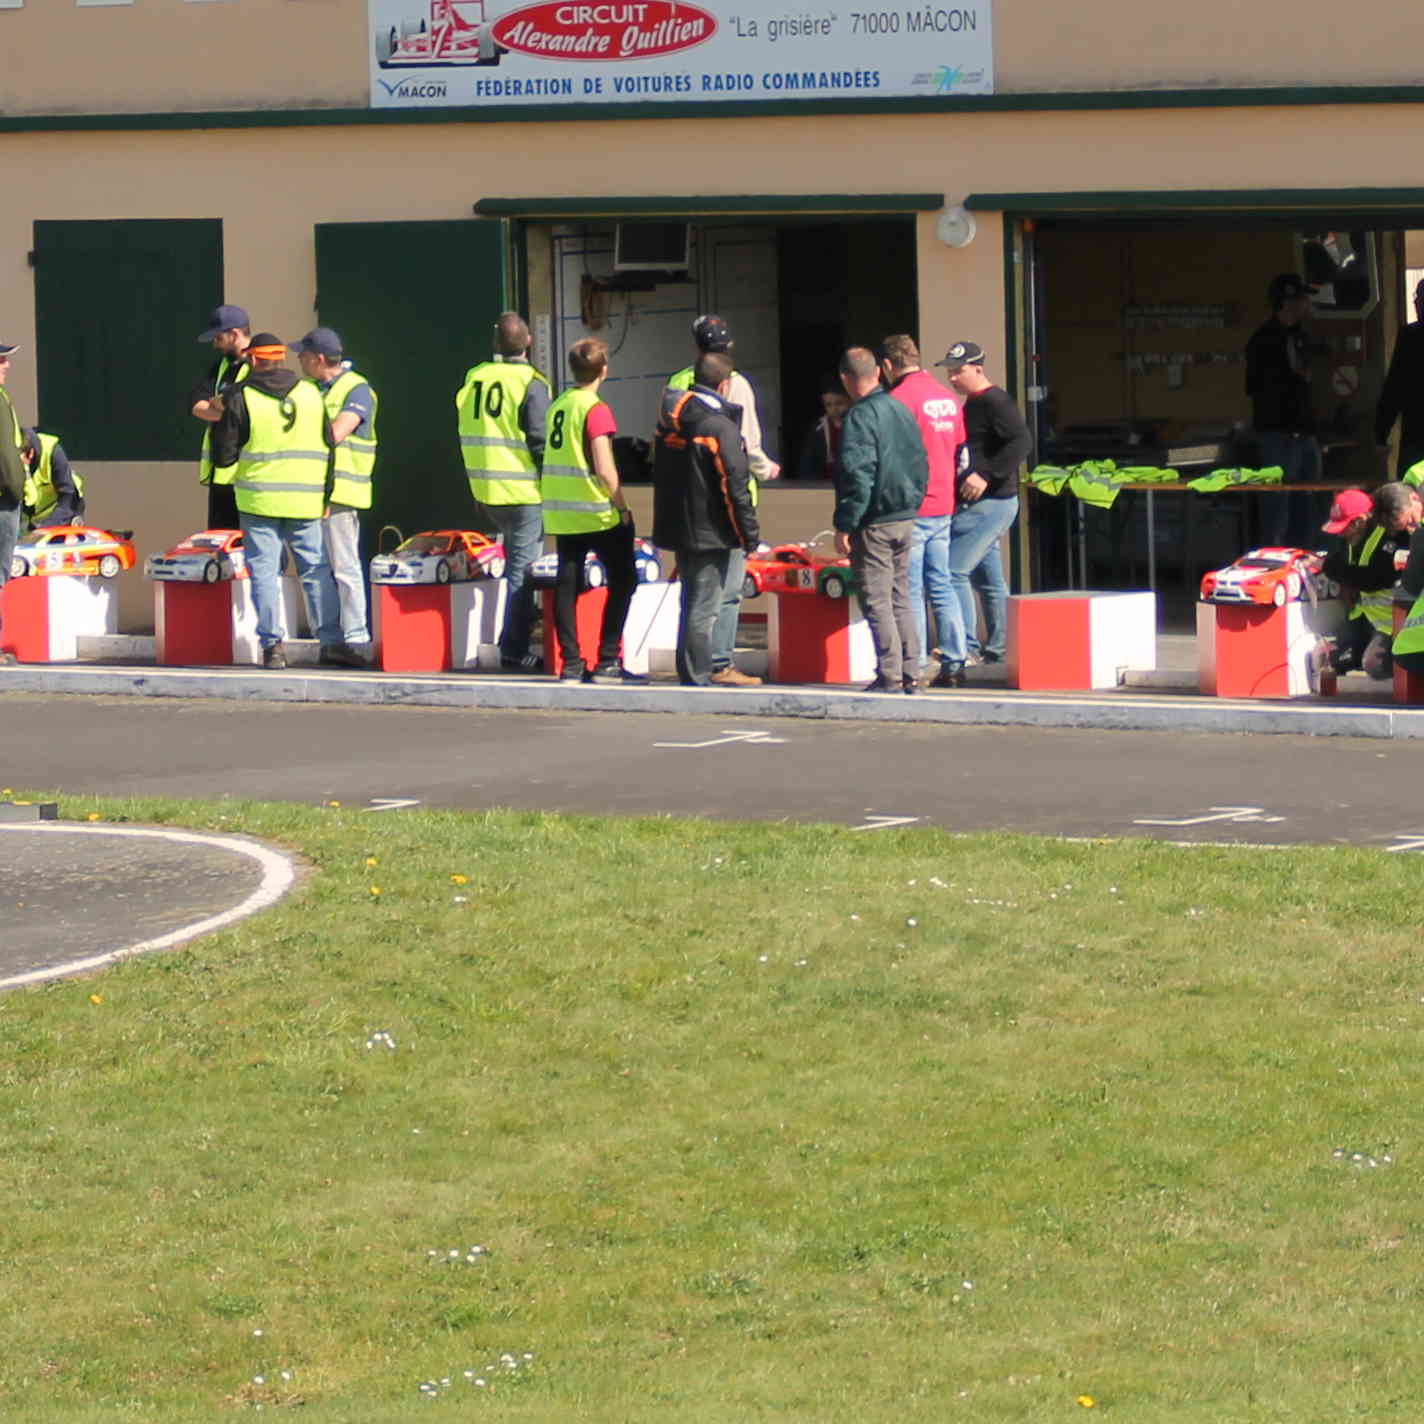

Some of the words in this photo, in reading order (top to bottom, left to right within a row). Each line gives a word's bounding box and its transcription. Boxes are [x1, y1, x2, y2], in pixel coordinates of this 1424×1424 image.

[556, 4, 648, 24] CIRCUIT
[850, 12, 900, 34] 71000
[907, 5, 977, 32] MÂCON
[503, 21, 610, 53] Alexandre
[584, 77, 602, 94] DE
[613, 76, 691, 93] VOITURES
[702, 74, 754, 91] RADIO
[279, 396, 296, 433] 9
[472, 380, 503, 418] 10
[550, 409, 565, 449] 8
